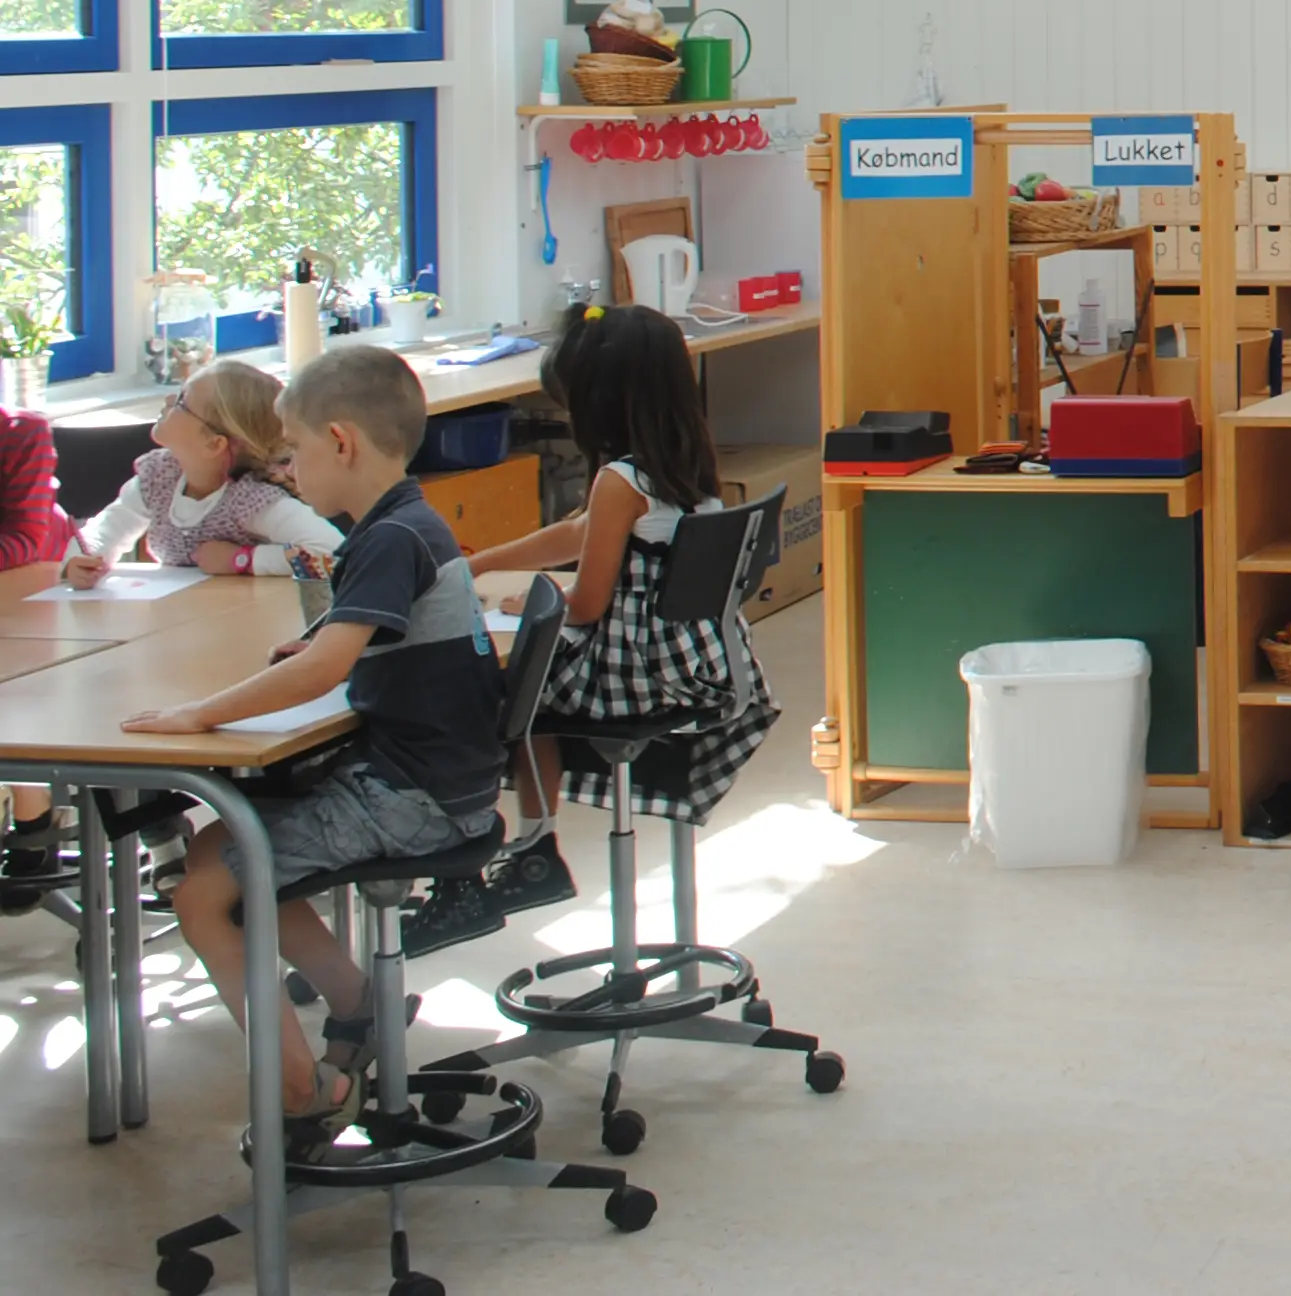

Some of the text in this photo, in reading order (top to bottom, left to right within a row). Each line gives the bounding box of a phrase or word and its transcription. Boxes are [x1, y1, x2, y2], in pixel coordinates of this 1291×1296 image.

[857, 145, 959, 169] Købmand
[1105, 138, 1186, 162] Lukket
[1153, 191, 1166, 206] a
[1189, 184, 1201, 206] b
[1267, 185, 1278, 206] d
[1155, 241, 1167, 265] p
[1269, 241, 1281, 256] s
